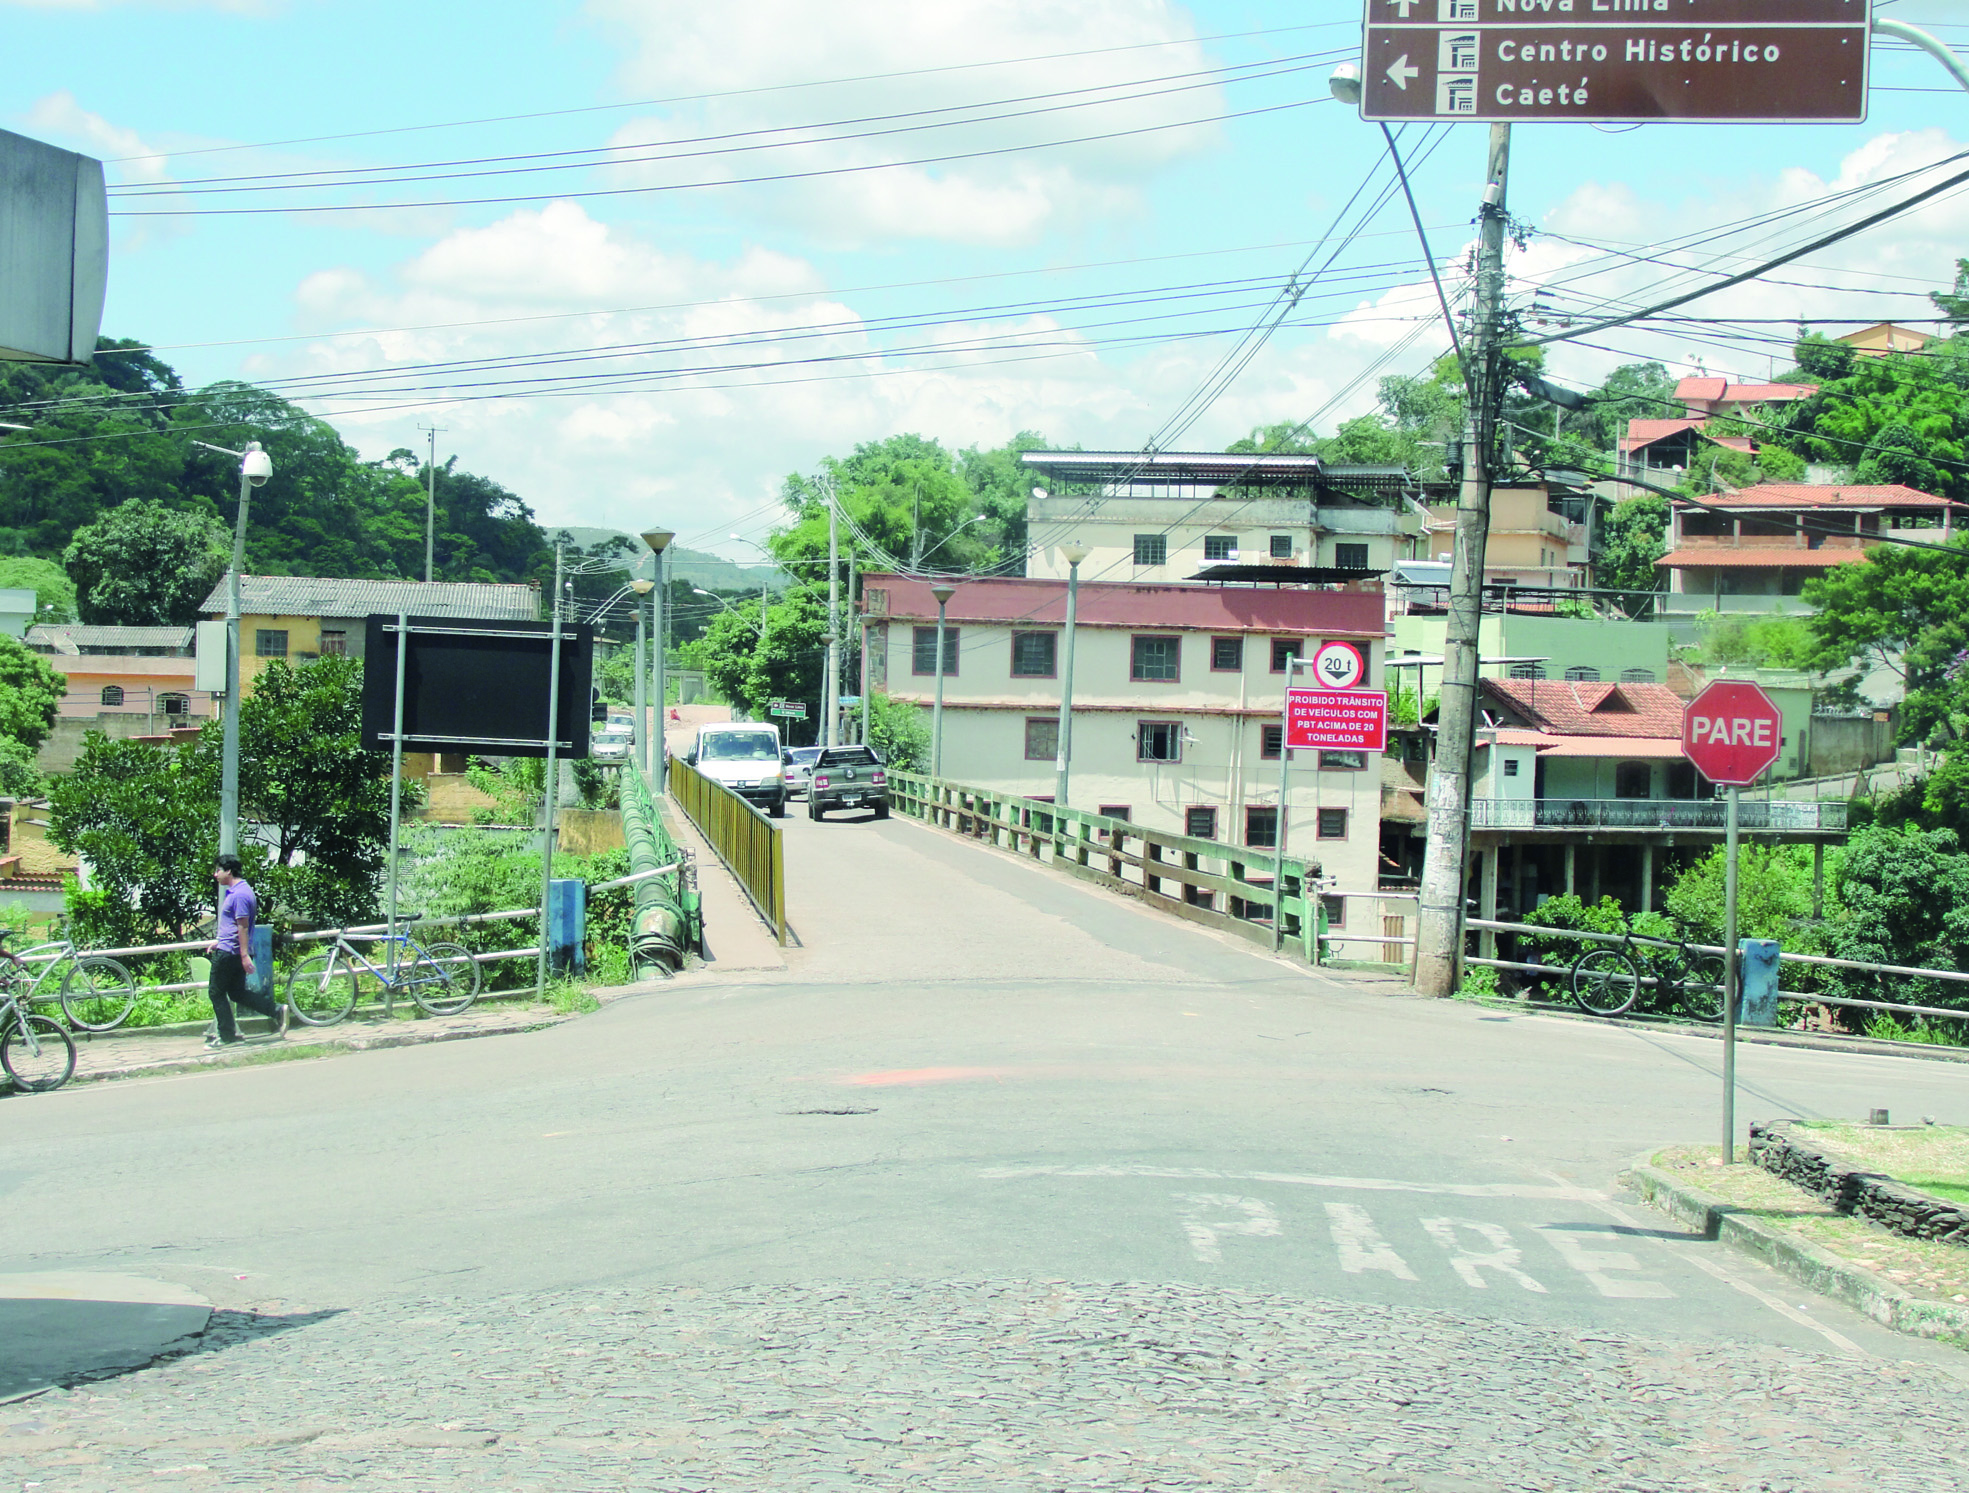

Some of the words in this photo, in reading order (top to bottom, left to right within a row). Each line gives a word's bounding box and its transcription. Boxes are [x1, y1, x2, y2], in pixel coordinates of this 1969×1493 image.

[1497, 0, 1574, 12] Nova
[1498, 40, 1608, 62] Centro
[1625, 33, 1780, 62] Histórico
[1496, 77, 1589, 105] Caeté
[1324, 657, 1342, 671] 20
[1346, 659, 1352, 671] t
[1289, 696, 1335, 705] PROIBIDO
[1337, 696, 1383, 707] TRÂNSITO
[1294, 708, 1307, 716] DE
[1309, 708, 1356, 718] VEÍCULOS
[1357, 710, 1378, 719] COM
[1297, 720, 1316, 729] PBT
[1317, 721, 1347, 730] ACIMA
[1348, 722, 1362, 731] DE
[1363, 723, 1374, 731] 20
[1691, 716, 1772, 747] PARE
[1307, 733, 1364, 743] TONELADAS
[1178, 1192, 1680, 1299] PARE
